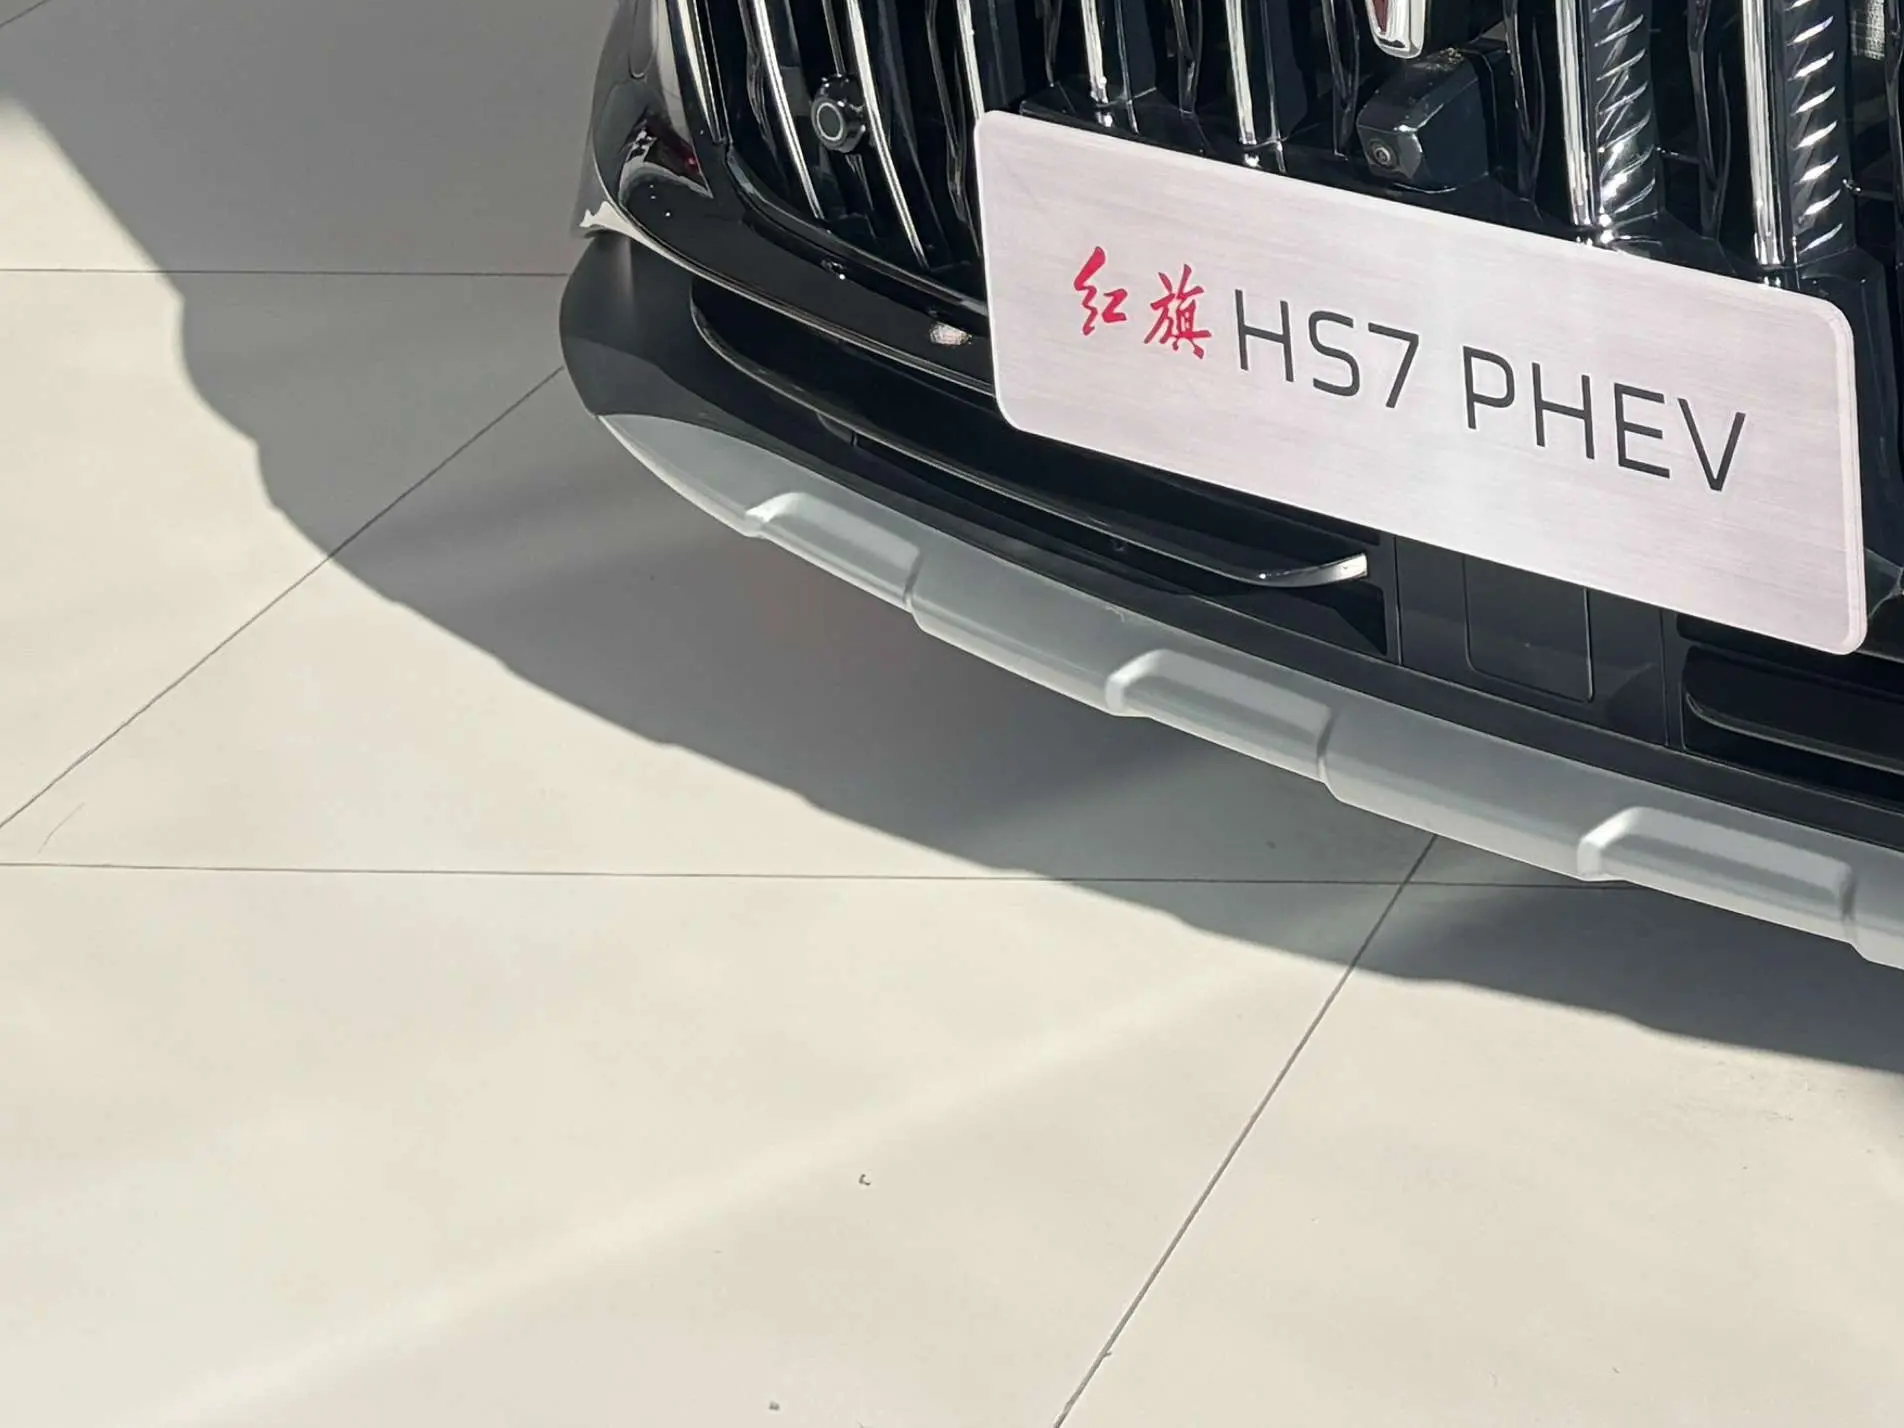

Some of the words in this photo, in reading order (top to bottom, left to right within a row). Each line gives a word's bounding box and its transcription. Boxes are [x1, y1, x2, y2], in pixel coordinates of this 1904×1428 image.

[1072, 245, 1212, 360] 红旗
[1235, 288, 1420, 410] HS7
[1463, 344, 1747, 493] PHEV
